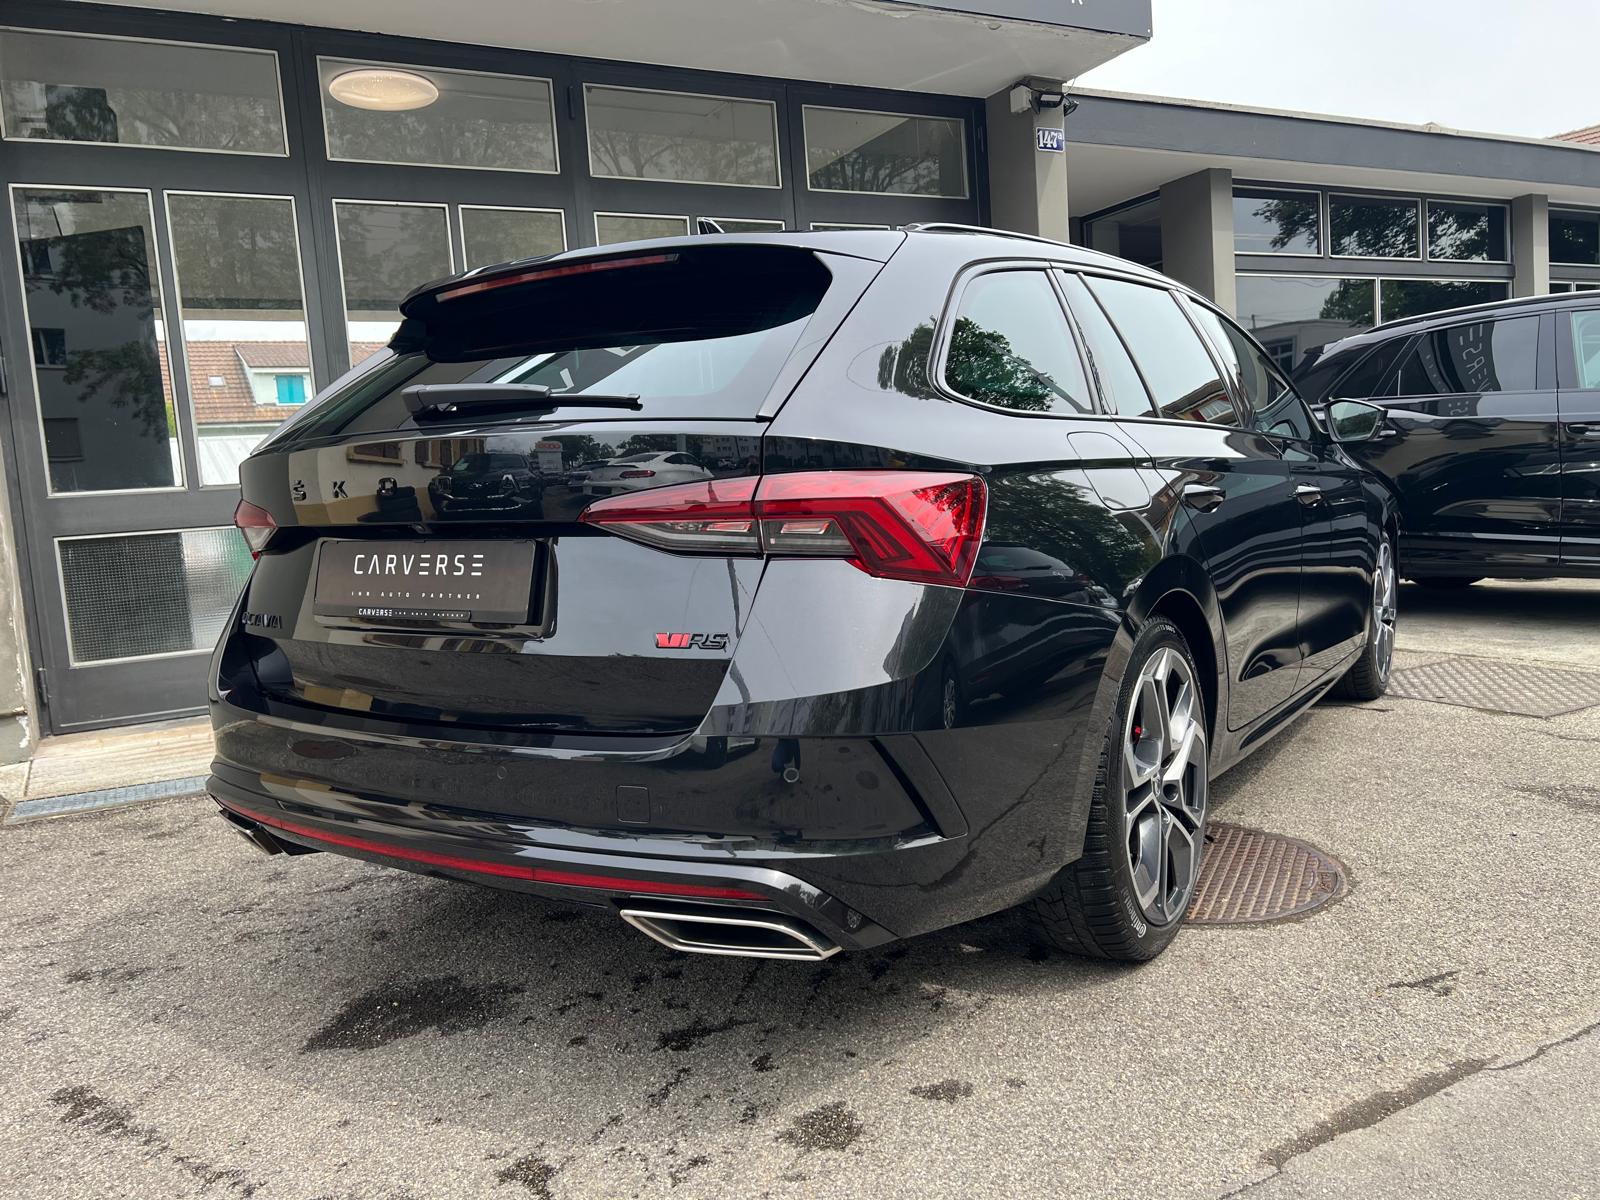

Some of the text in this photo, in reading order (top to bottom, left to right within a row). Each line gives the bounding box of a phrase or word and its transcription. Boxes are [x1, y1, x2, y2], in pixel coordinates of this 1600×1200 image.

[353, 554, 484, 576] CARVERSE
[421, 592, 480, 600] PARTNER
[358, 608, 393, 617] CARVERSE
